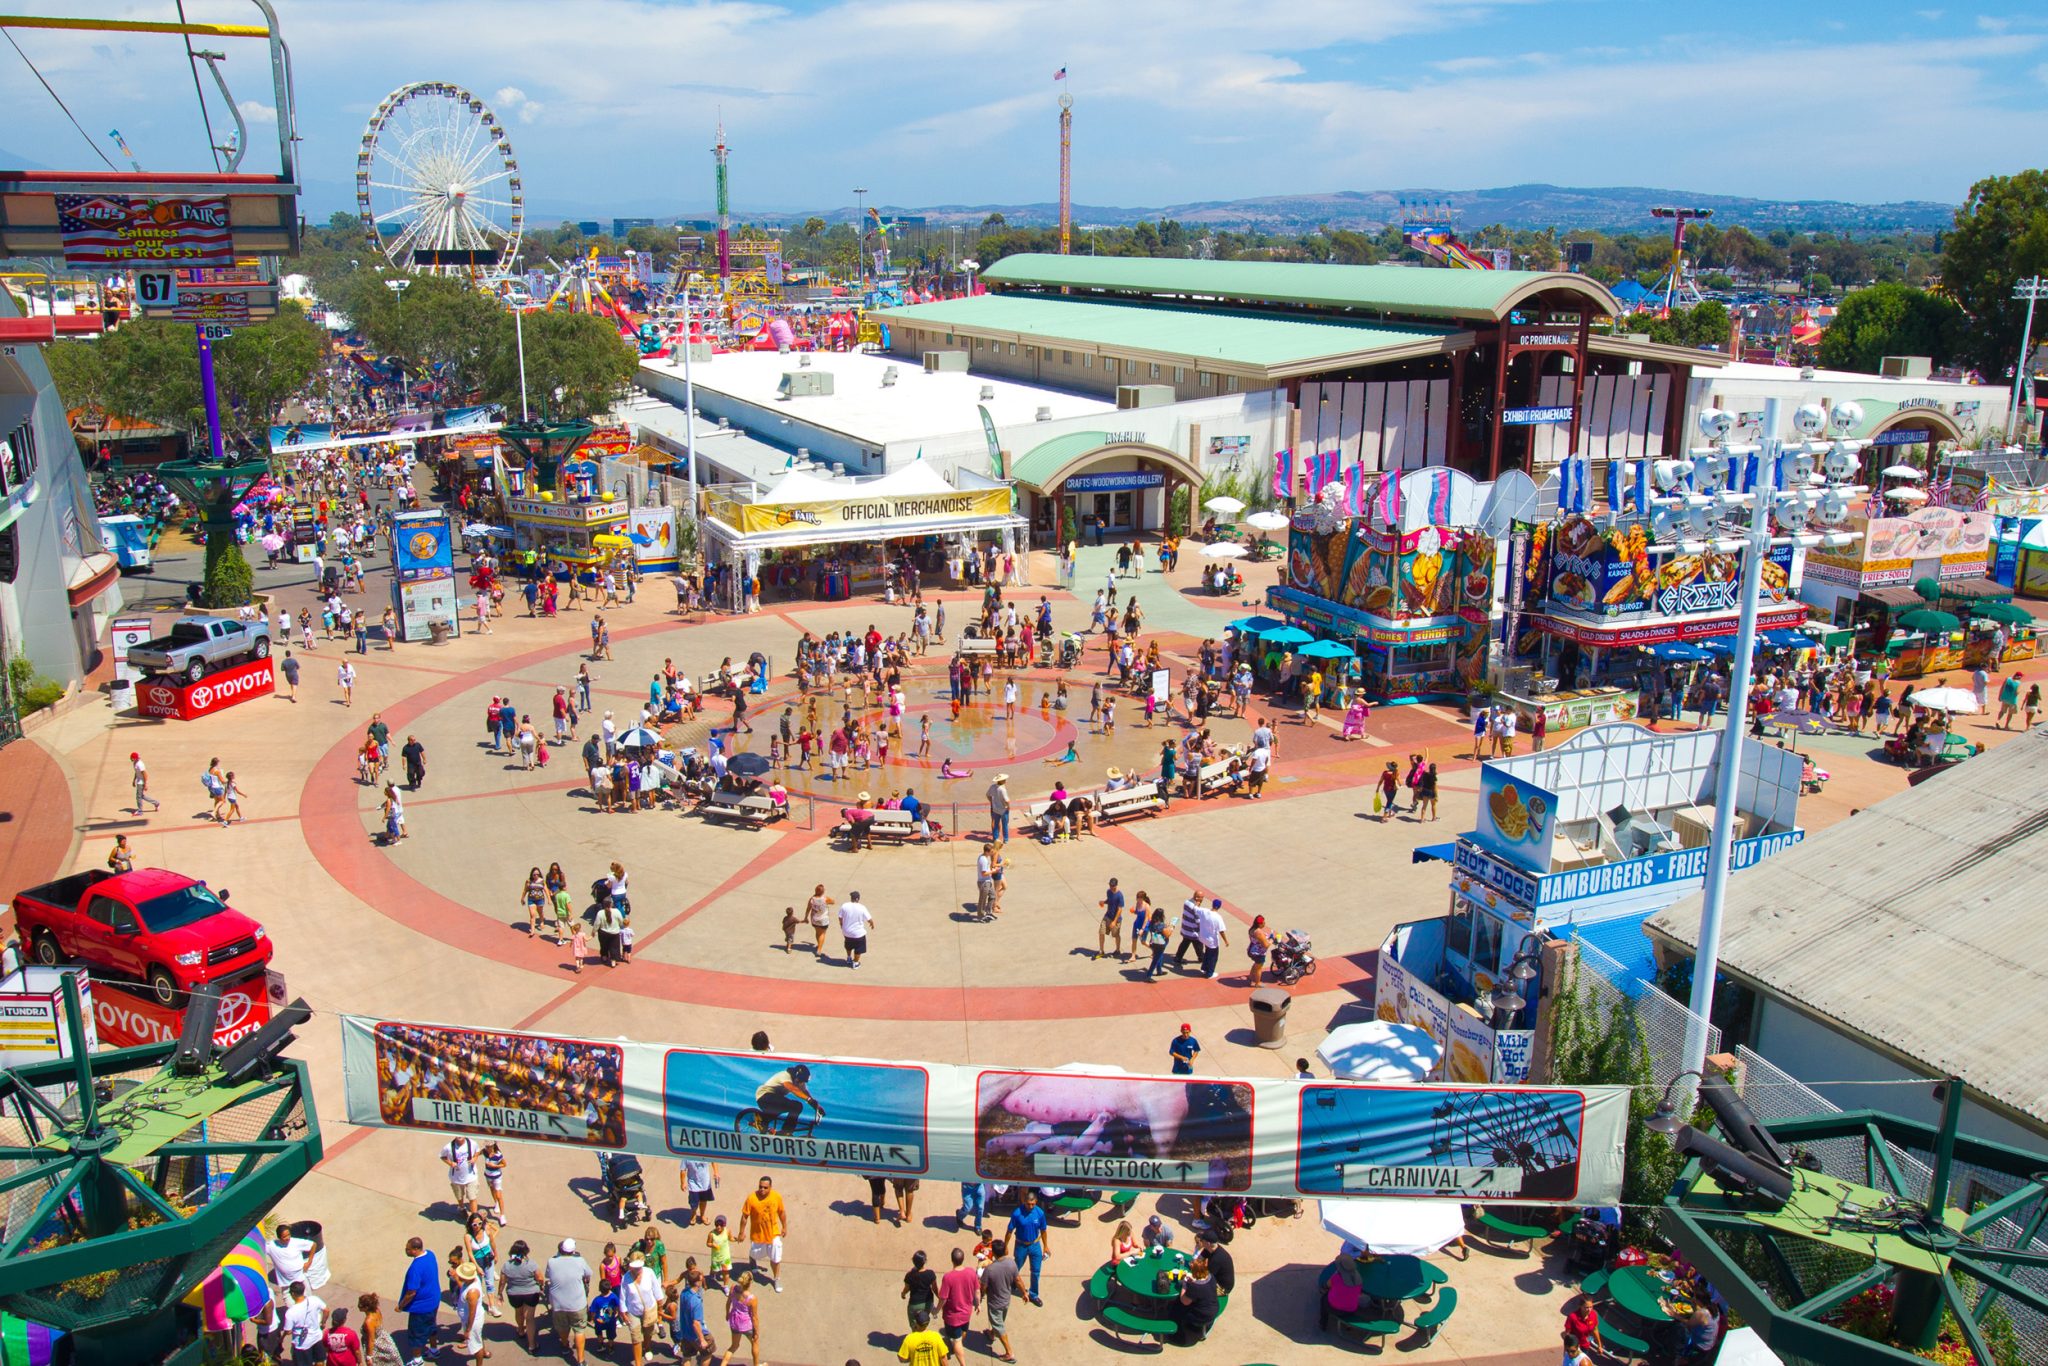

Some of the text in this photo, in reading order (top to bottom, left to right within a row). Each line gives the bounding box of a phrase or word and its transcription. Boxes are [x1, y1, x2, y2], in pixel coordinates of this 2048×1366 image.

[181, 204, 226, 226] FAIR
[116, 226, 179, 239] Salutes
[134, 239, 164, 249] our
[104, 247, 203, 259] HEROES!
[139, 273, 171, 301] 67
[205, 325, 223, 339] 66
[1520, 334, 1569, 345] OC PROMENADE
[4, 347, 16, 356] 24
[1503, 407, 1573, 423] EXHIBIT PROMENADE
[1906, 430, 1930, 442] GALLERY
[1066, 474, 1164, 489] CRAFTS WOODWORKING GALLERY
[794, 508, 822, 526] FAIR
[842, 503, 892, 520] OFFICIAL
[894, 496, 973, 517] MERCHANDISE
[1554, 551, 1602, 579] GYROS
[1608, 561, 1634, 570] CHICKEN
[1608, 569, 1632, 577] KABOBS
[1863, 572, 1885, 582] FRIES
[1772, 614, 1798, 623] KABOBS
[1620, 629, 1644, 640] SALADS
[1650, 626, 1676, 637] DINNERS
[1684, 620, 1738, 633] CHICKEN PITAS
[1375, 632, 1403, 641] CONES
[1415, 630, 1460, 641] SUNDAES
[1581, 630, 1595, 640] COLD
[213, 669, 273, 700] TOYOTA
[147, 706, 180, 717] TOYOTA
[1456, 845, 1535, 902] HOT DOGS
[1539, 859, 1653, 904] HAMBURGERS
[6, 1007, 47, 1016] TUNDRA
[1498, 1033, 1529, 1048] Mile
[1502, 1048, 1525, 1063] Hot
[1505, 1063, 1529, 1080] Dog
[432, 1101, 540, 1131] THE HANGAR
[679, 1127, 884, 1163] ACTION SPORTS ARENA
[1064, 1157, 1163, 1179] LIVESTOCK
[1368, 1167, 1462, 1188] CARNIVAL
